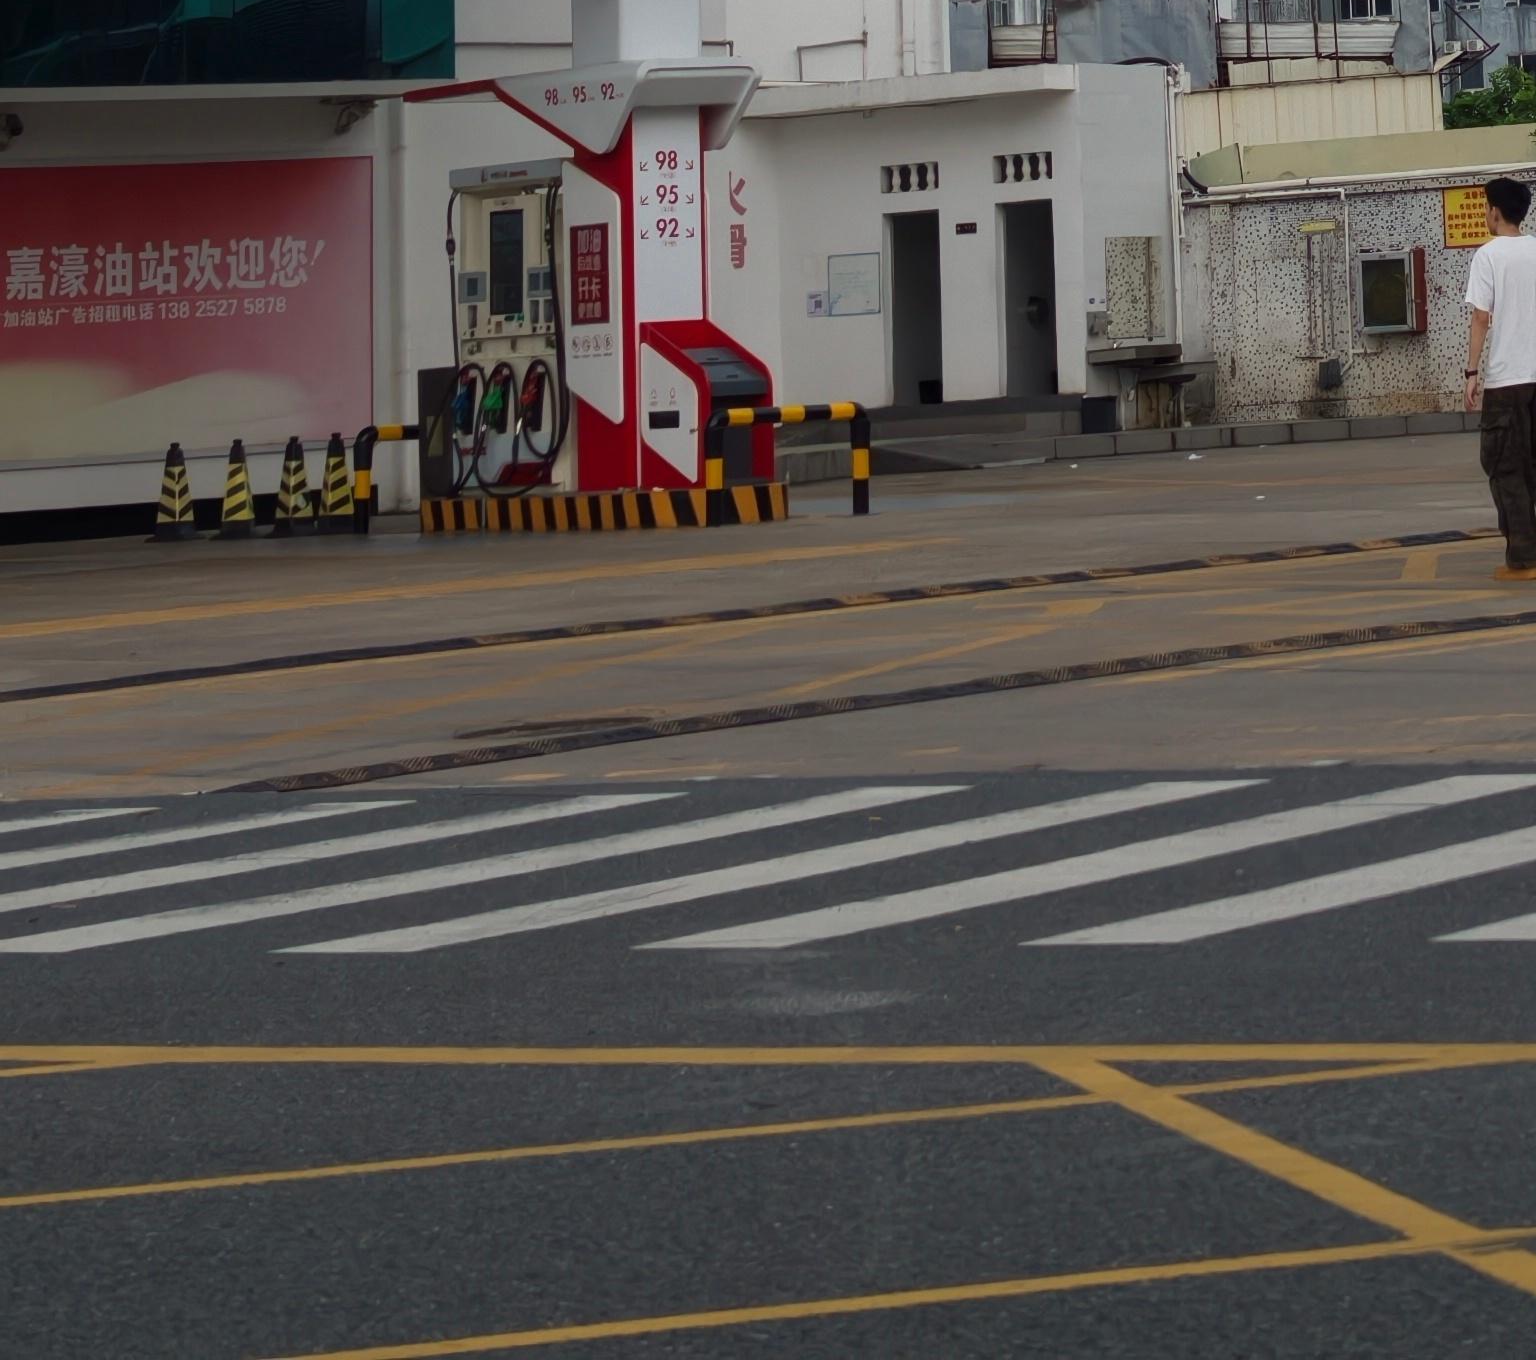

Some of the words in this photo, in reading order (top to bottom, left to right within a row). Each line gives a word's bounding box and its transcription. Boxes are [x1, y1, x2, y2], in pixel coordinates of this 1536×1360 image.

[544, 88, 559, 106] 98
[572, 86, 587, 103] 95
[601, 82, 615, 100] 92
[655, 150, 678, 170] 98
[656, 184, 679, 205] 95
[656, 218, 680, 238] 92
[195, 298, 238, 318] 2527
[243, 296, 288, 315] 5878
